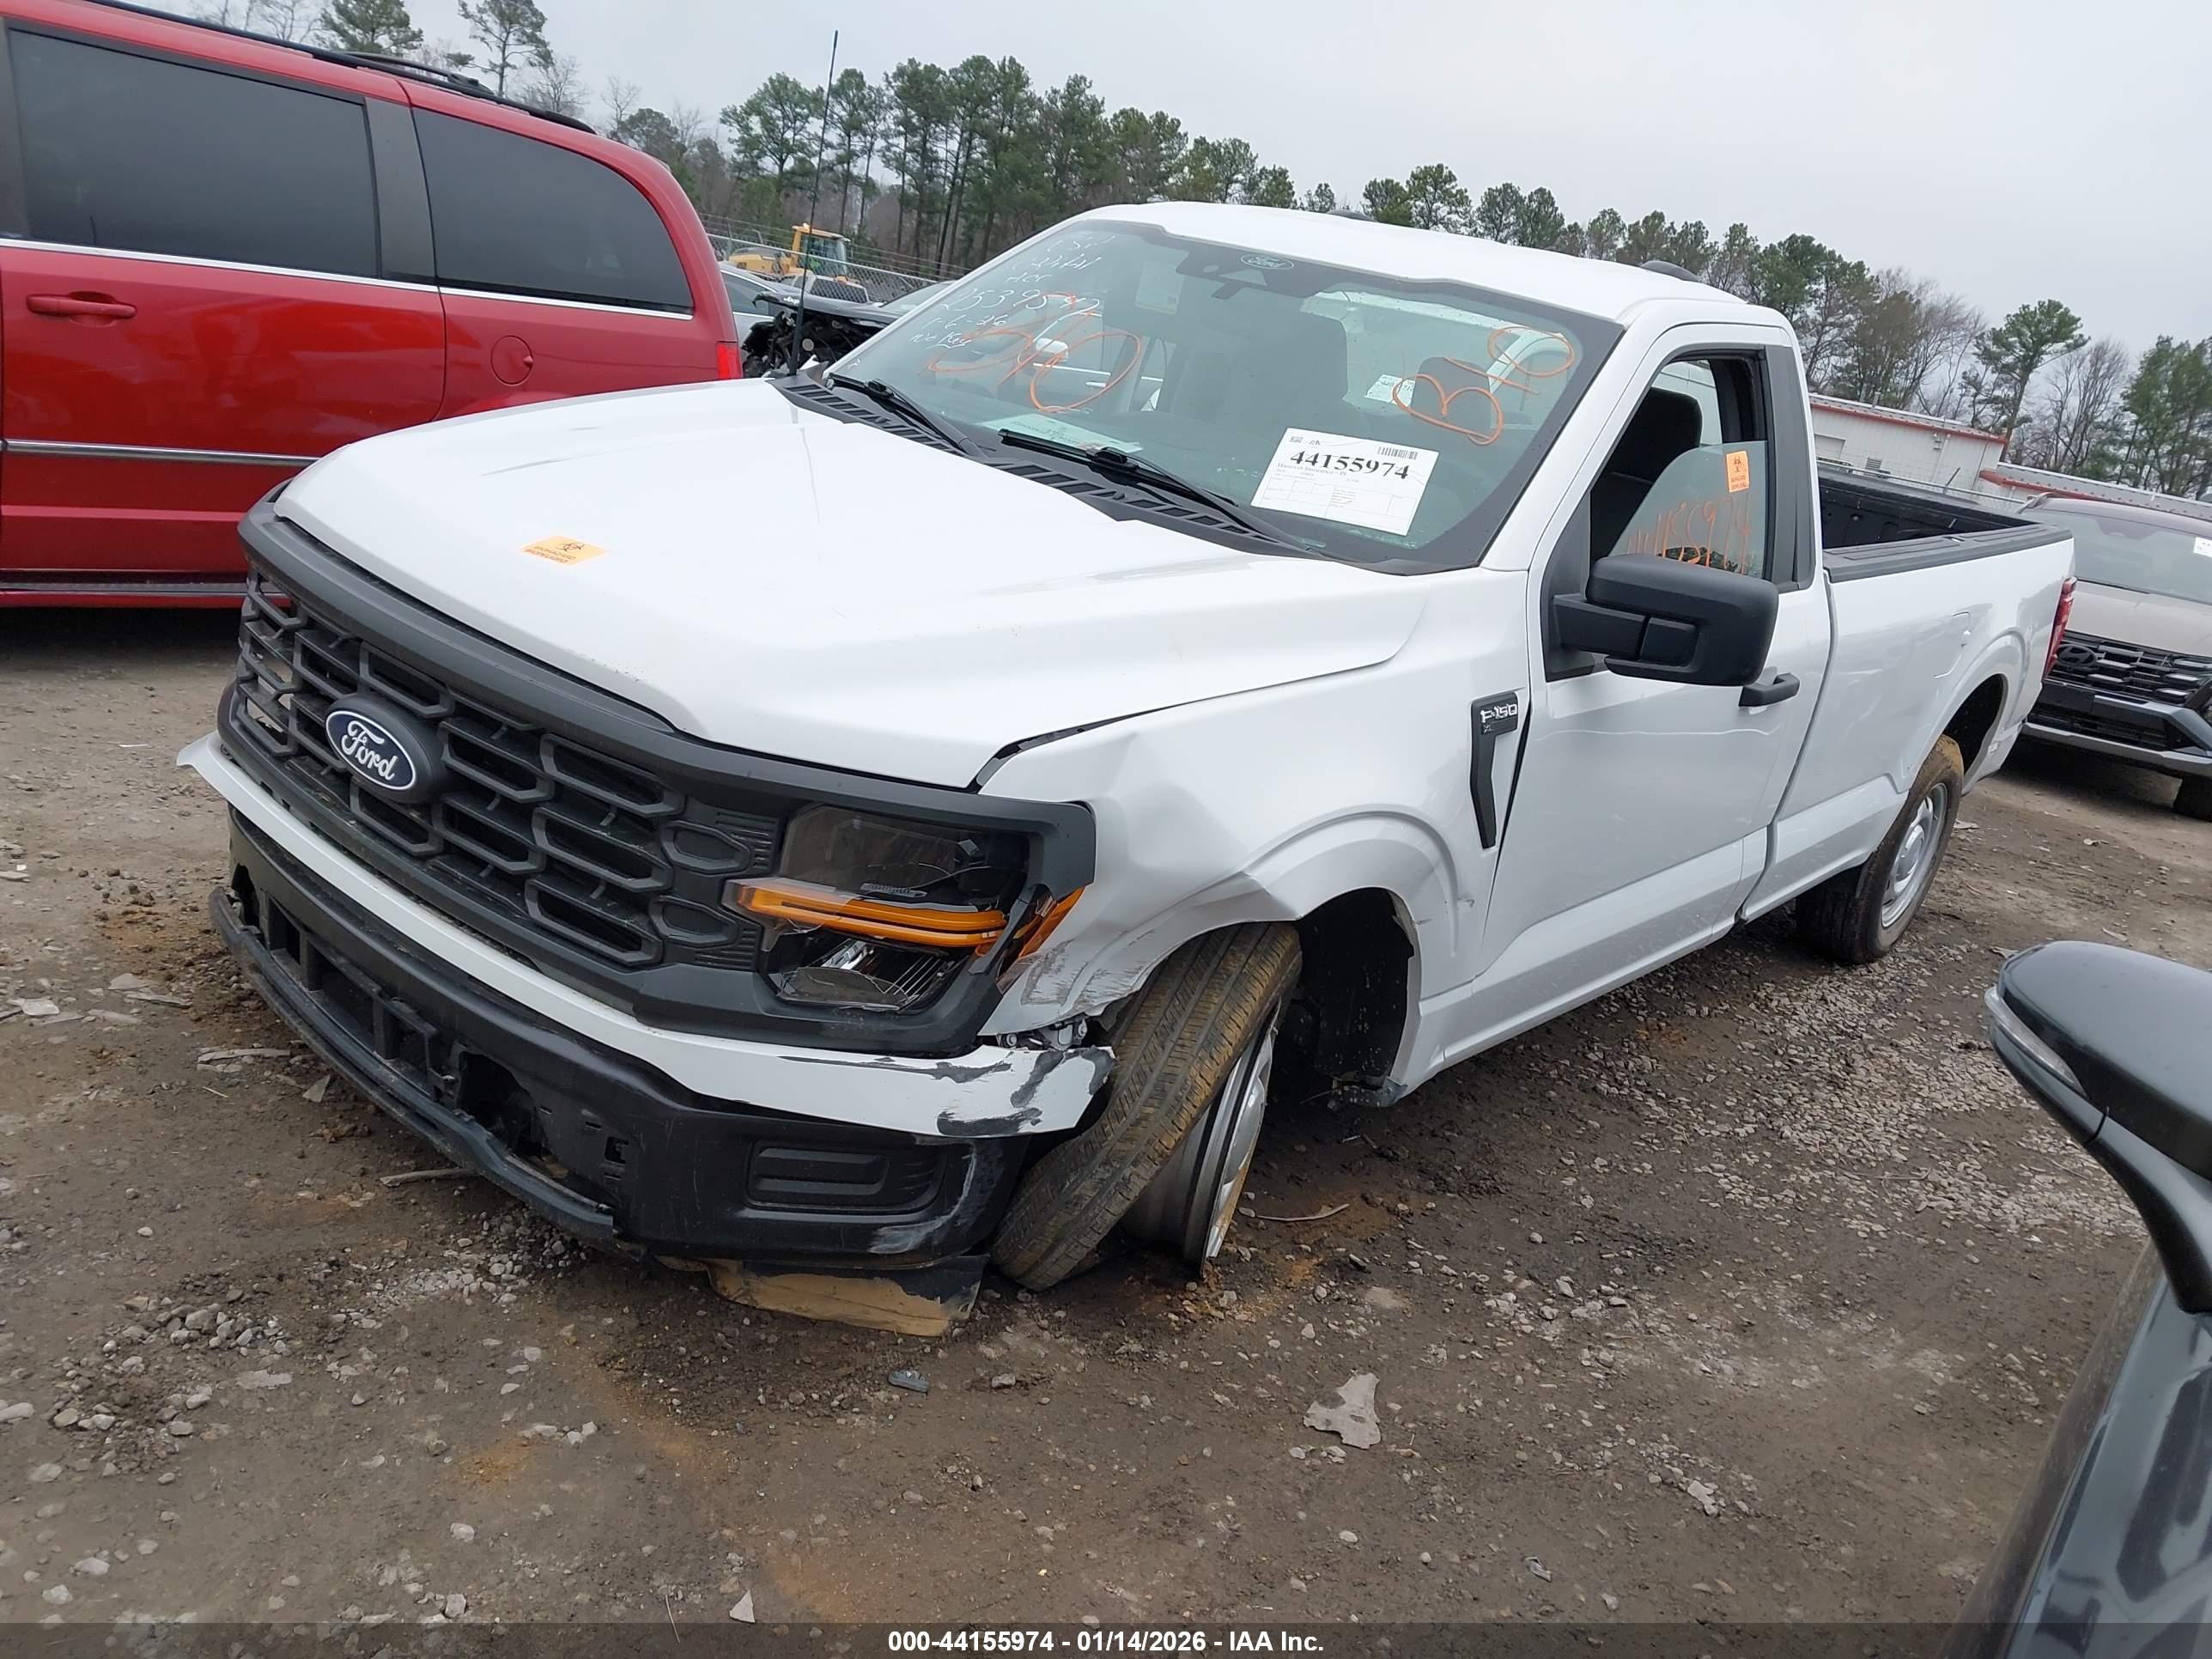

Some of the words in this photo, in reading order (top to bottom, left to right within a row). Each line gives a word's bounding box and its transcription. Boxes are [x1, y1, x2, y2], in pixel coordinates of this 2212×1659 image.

[1290, 449, 1410, 480] 44155974
[1480, 702, 1518, 723] F-150
[341, 720, 398, 781] Ford
